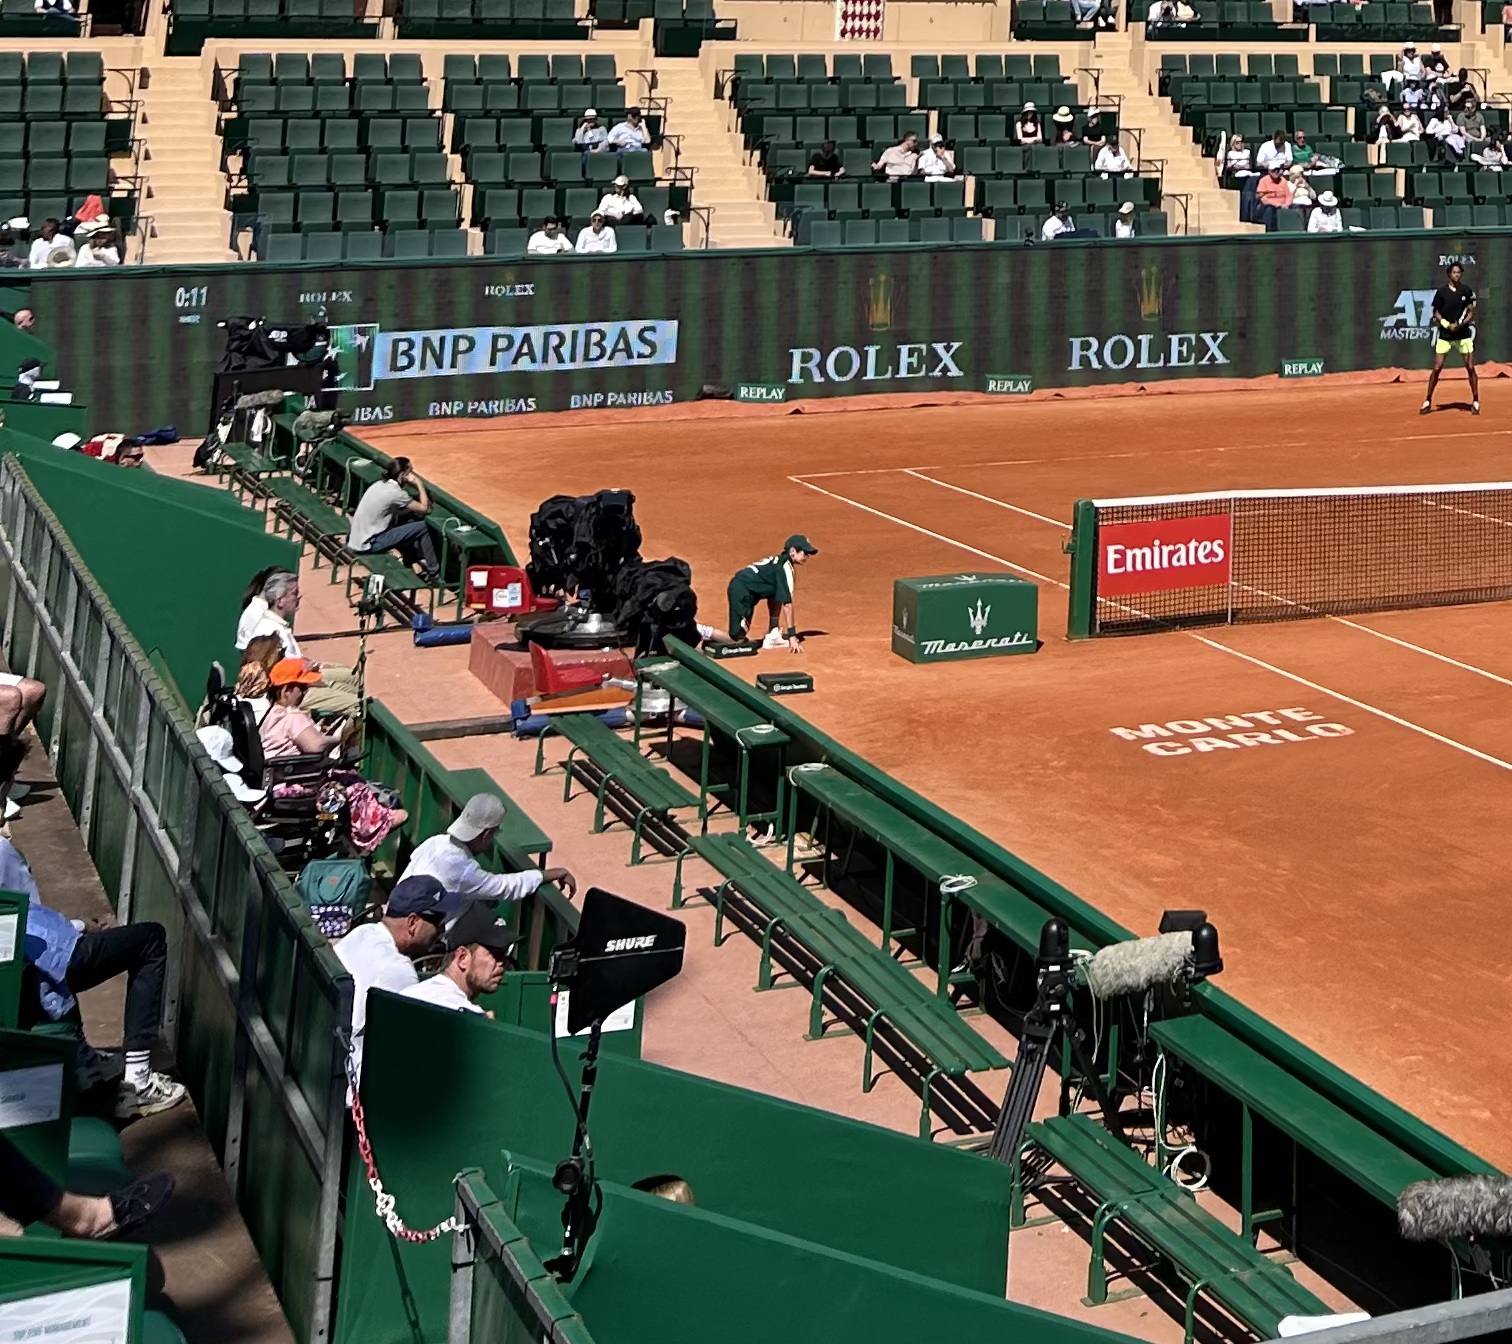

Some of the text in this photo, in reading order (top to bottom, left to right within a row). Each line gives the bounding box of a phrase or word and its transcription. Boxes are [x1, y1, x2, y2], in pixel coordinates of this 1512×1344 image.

[175, 286, 208, 307] 0:11
[484, 283, 536, 297] ROLEX
[1379, 326, 1430, 341] MASTERS
[389, 325, 658, 373] BNP PARIBAS
[1067, 331, 1231, 371] ROLEX
[787, 341, 964, 384] ROLEX
[1283, 361, 1324, 376] REPLAY
[739, 386, 786, 400] REPLAY
[988, 379, 1032, 393] REPLAY
[428, 397, 537, 416] BNP PARIBAS
[570, 390, 674, 408] BNP PARIBAS
[1106, 537, 1225, 574] Emirates
[921, 632, 1034, 656] Maserati
[1108, 706, 1324, 741] MONTE
[1141, 722, 1356, 756] CARLO
[604, 934, 658, 952] SHURE
